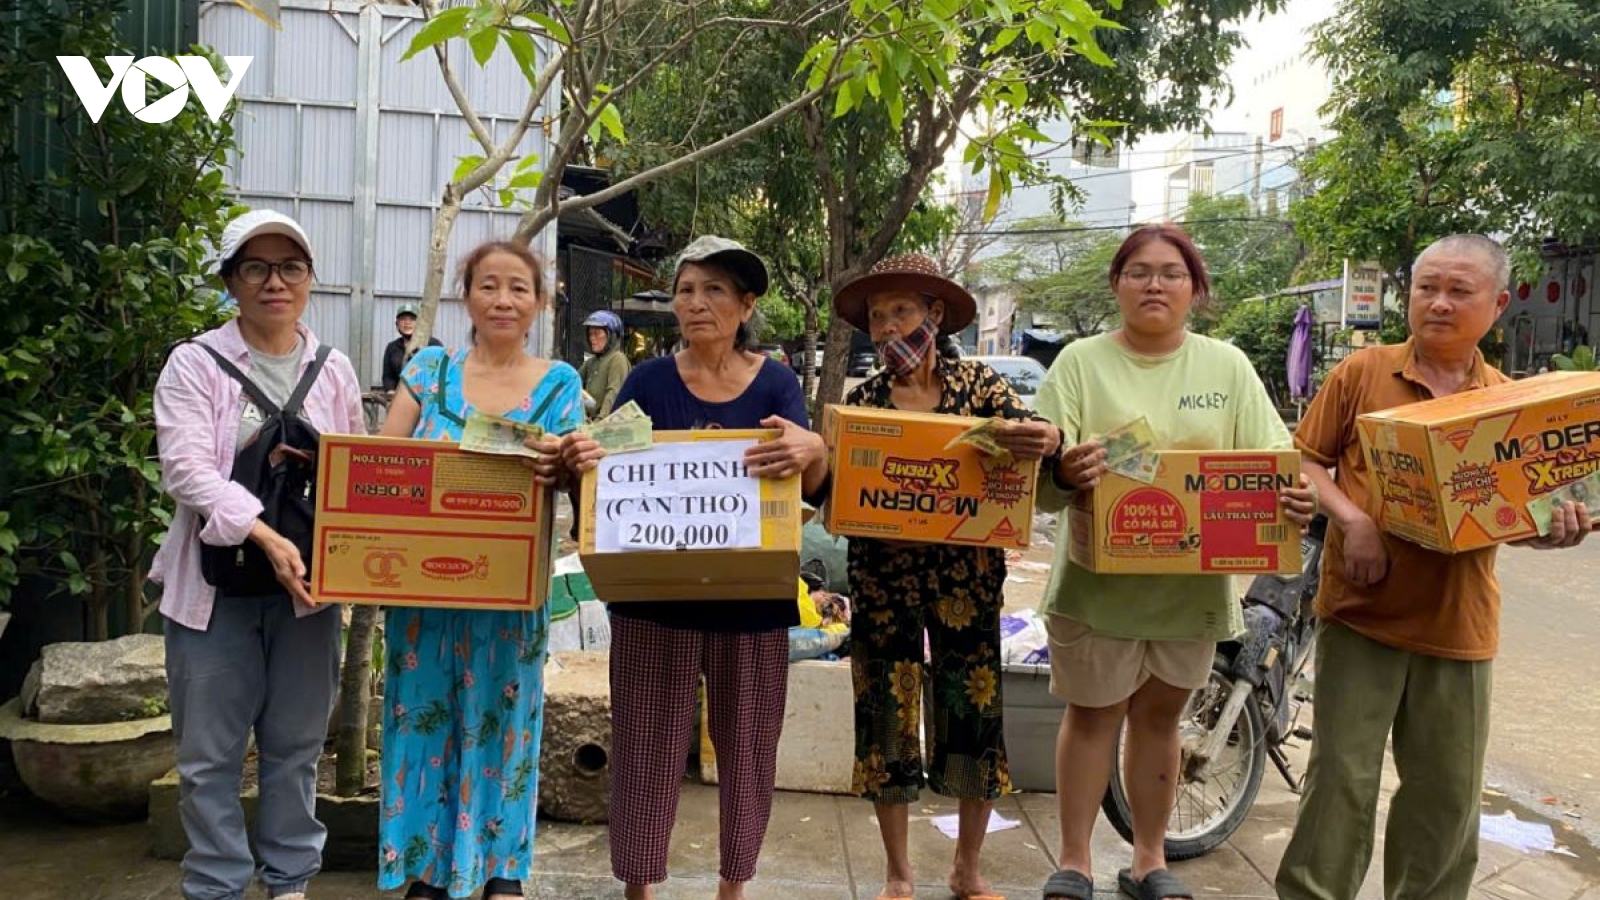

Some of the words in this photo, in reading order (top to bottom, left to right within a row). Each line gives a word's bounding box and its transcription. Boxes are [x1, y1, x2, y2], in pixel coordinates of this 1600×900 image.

[1178, 392, 1229, 410] MICKEY
[606, 463, 655, 486] CHỊ
[663, 460, 748, 480] TRINH
[885, 461, 953, 488] XTREME
[1184, 473, 1293, 493] MODERN
[1533, 460, 1600, 490] XTREM
[680, 493, 748, 516] THƠ)
[859, 488, 979, 517] MODERN
[1123, 504, 1158, 517] 100%
[1160, 504, 1176, 517] LY
